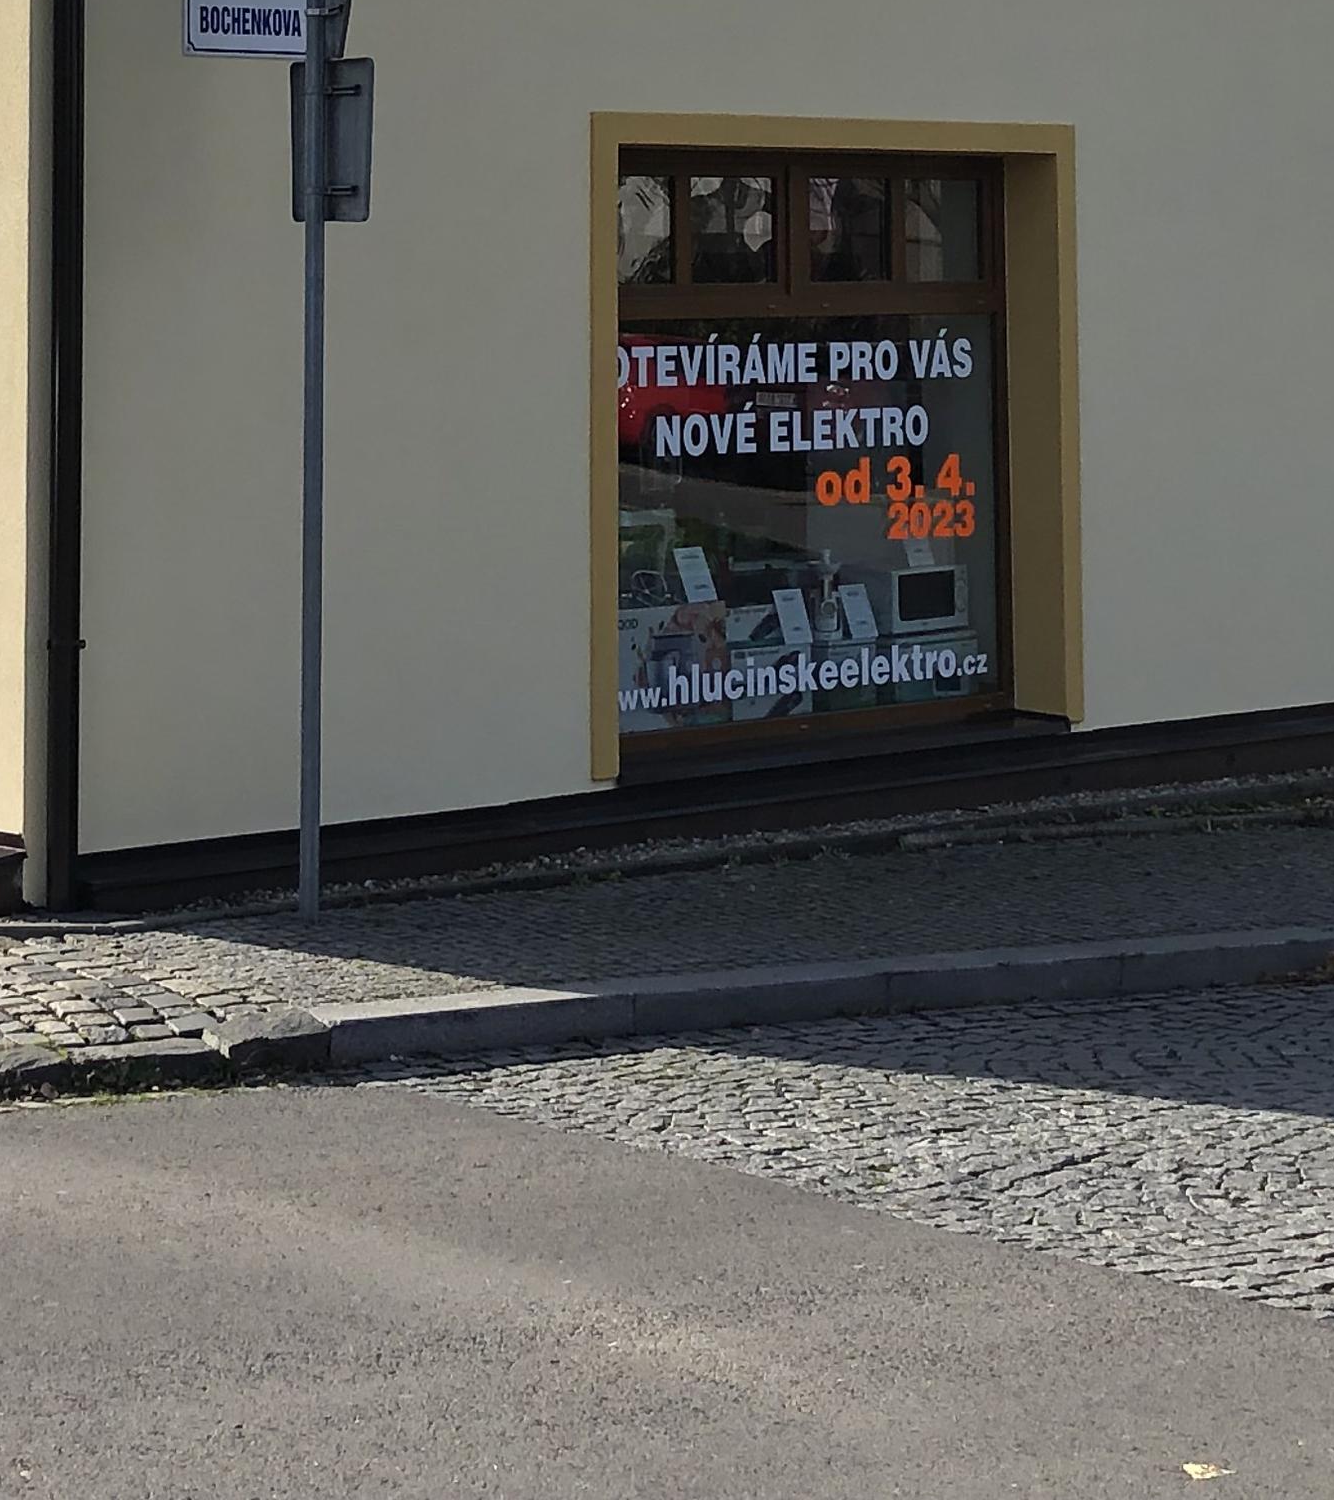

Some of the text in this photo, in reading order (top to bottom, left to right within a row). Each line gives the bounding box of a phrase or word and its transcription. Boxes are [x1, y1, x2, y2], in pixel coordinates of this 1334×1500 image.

[199, 5, 302, 38] BOCHENKOVA
[829, 339, 898, 382] PRO
[908, 328, 973, 379] VÁS
[655, 402, 929, 457] NOVÉ ELEKTRO
[816, 453, 975, 506] od 3. 4.
[887, 501, 975, 540] 2023
